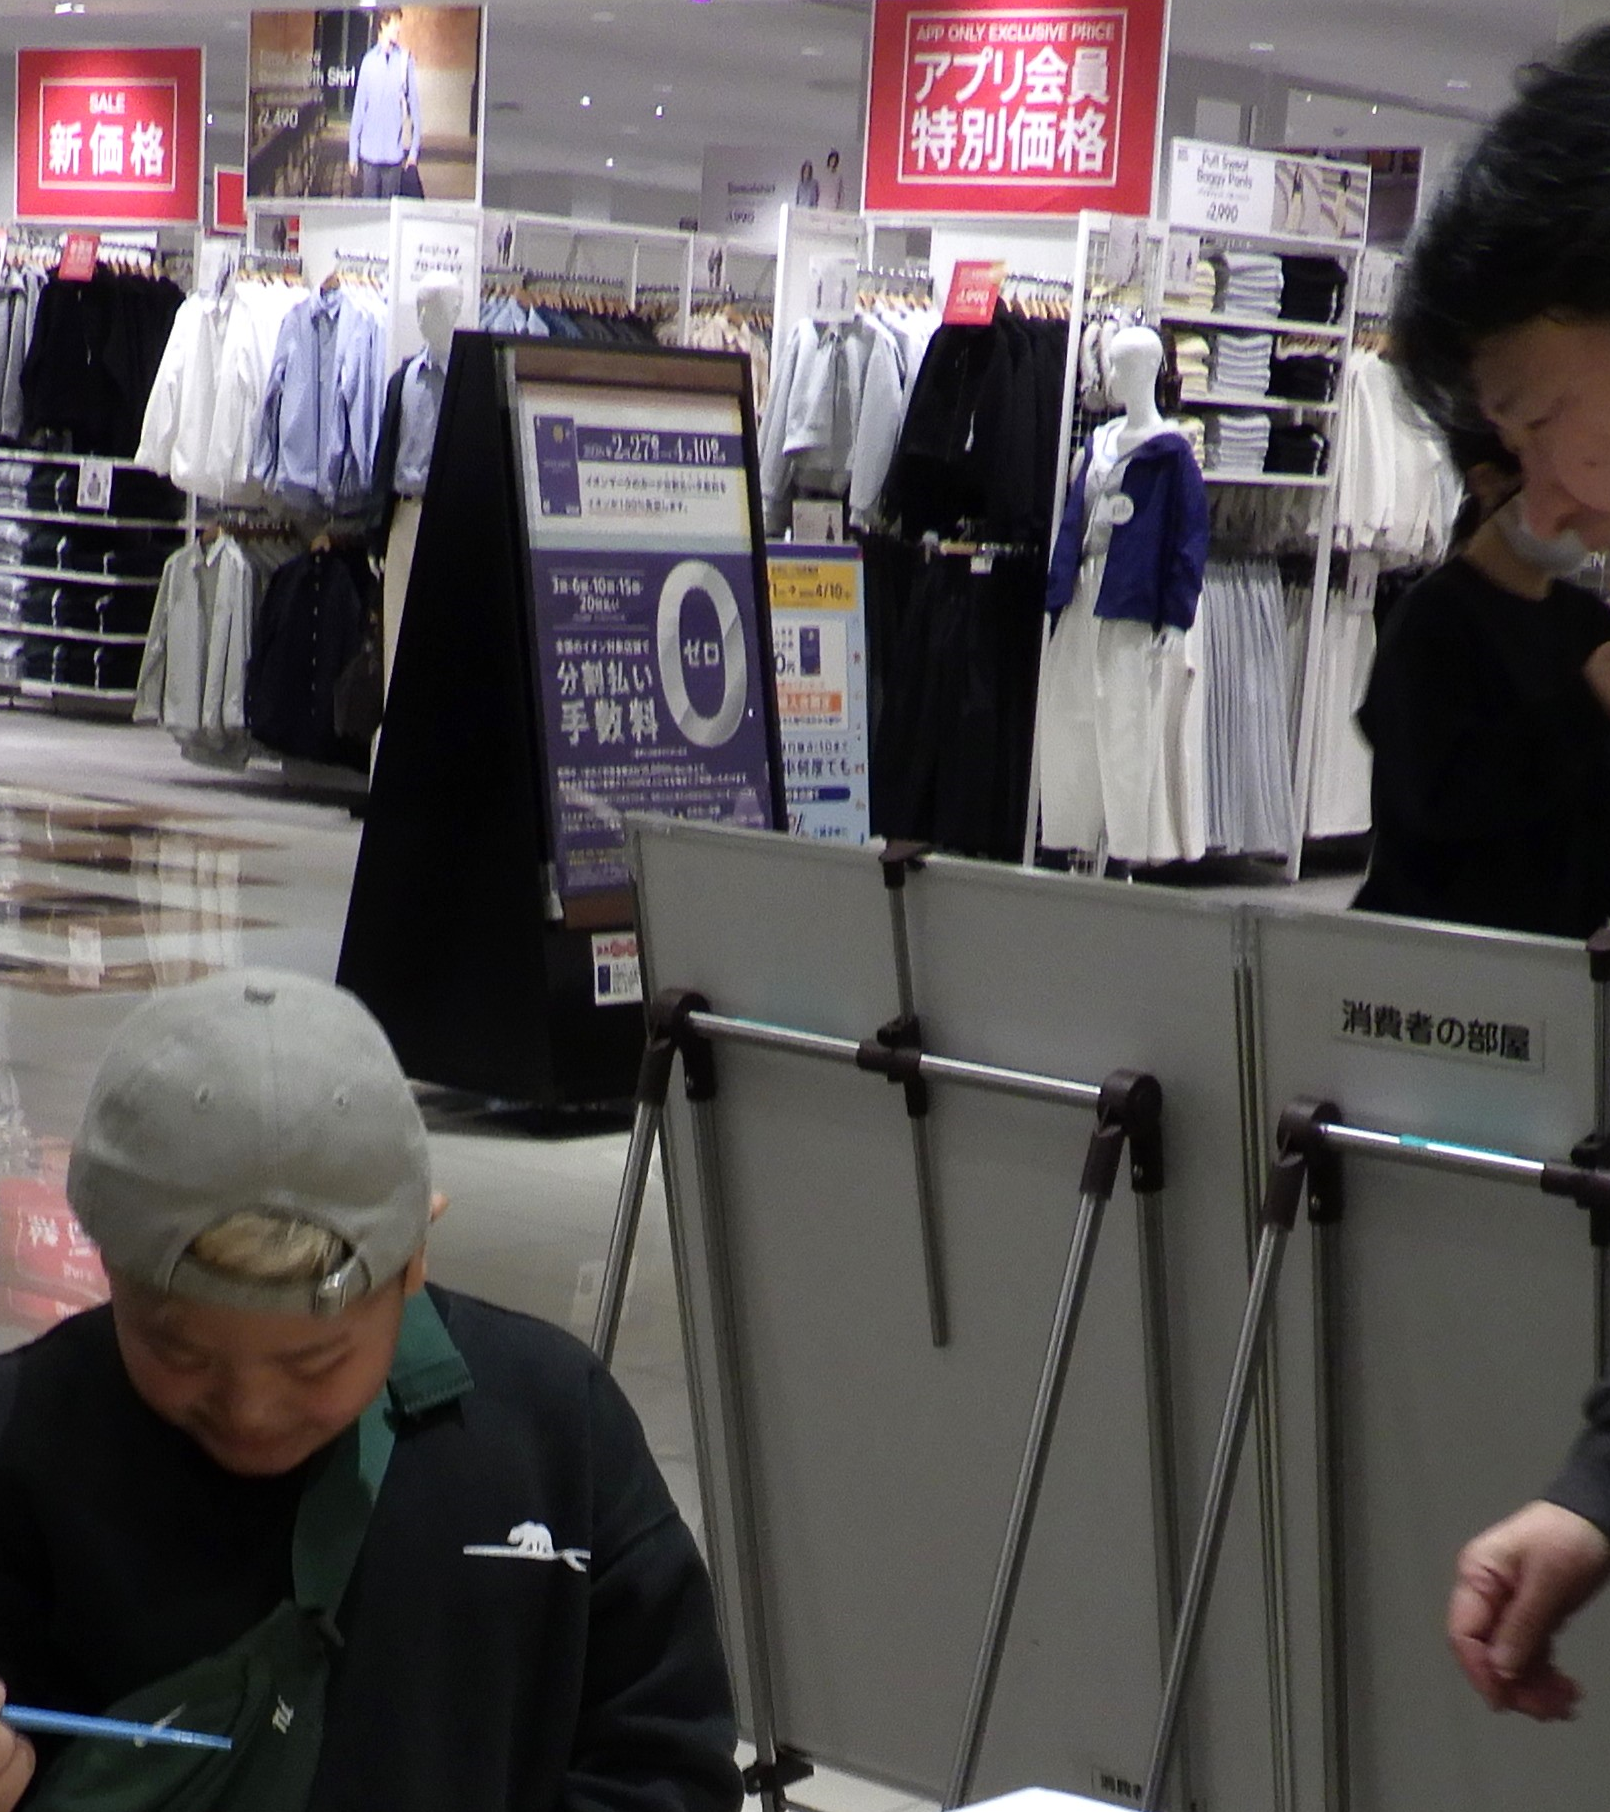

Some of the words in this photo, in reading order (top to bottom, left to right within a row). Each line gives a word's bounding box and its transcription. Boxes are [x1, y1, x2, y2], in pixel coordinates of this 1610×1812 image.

[948, 23, 986, 41] ONLY
[989, 22, 1067, 42] EXCLUSIVE
[1071, 22, 1115, 41] PRICE
[914, 45, 1110, 105] アプリ会員
[89, 92, 125, 115] SALE
[49, 120, 164, 176] 新価格
[911, 105, 1109, 173] 特別価格
[685, 637, 721, 668] ゼロ
[557, 660, 653, 696] 分割払い
[561, 697, 659, 747] 手数料
[1342, 998, 1530, 1062] 消費者の部屋
